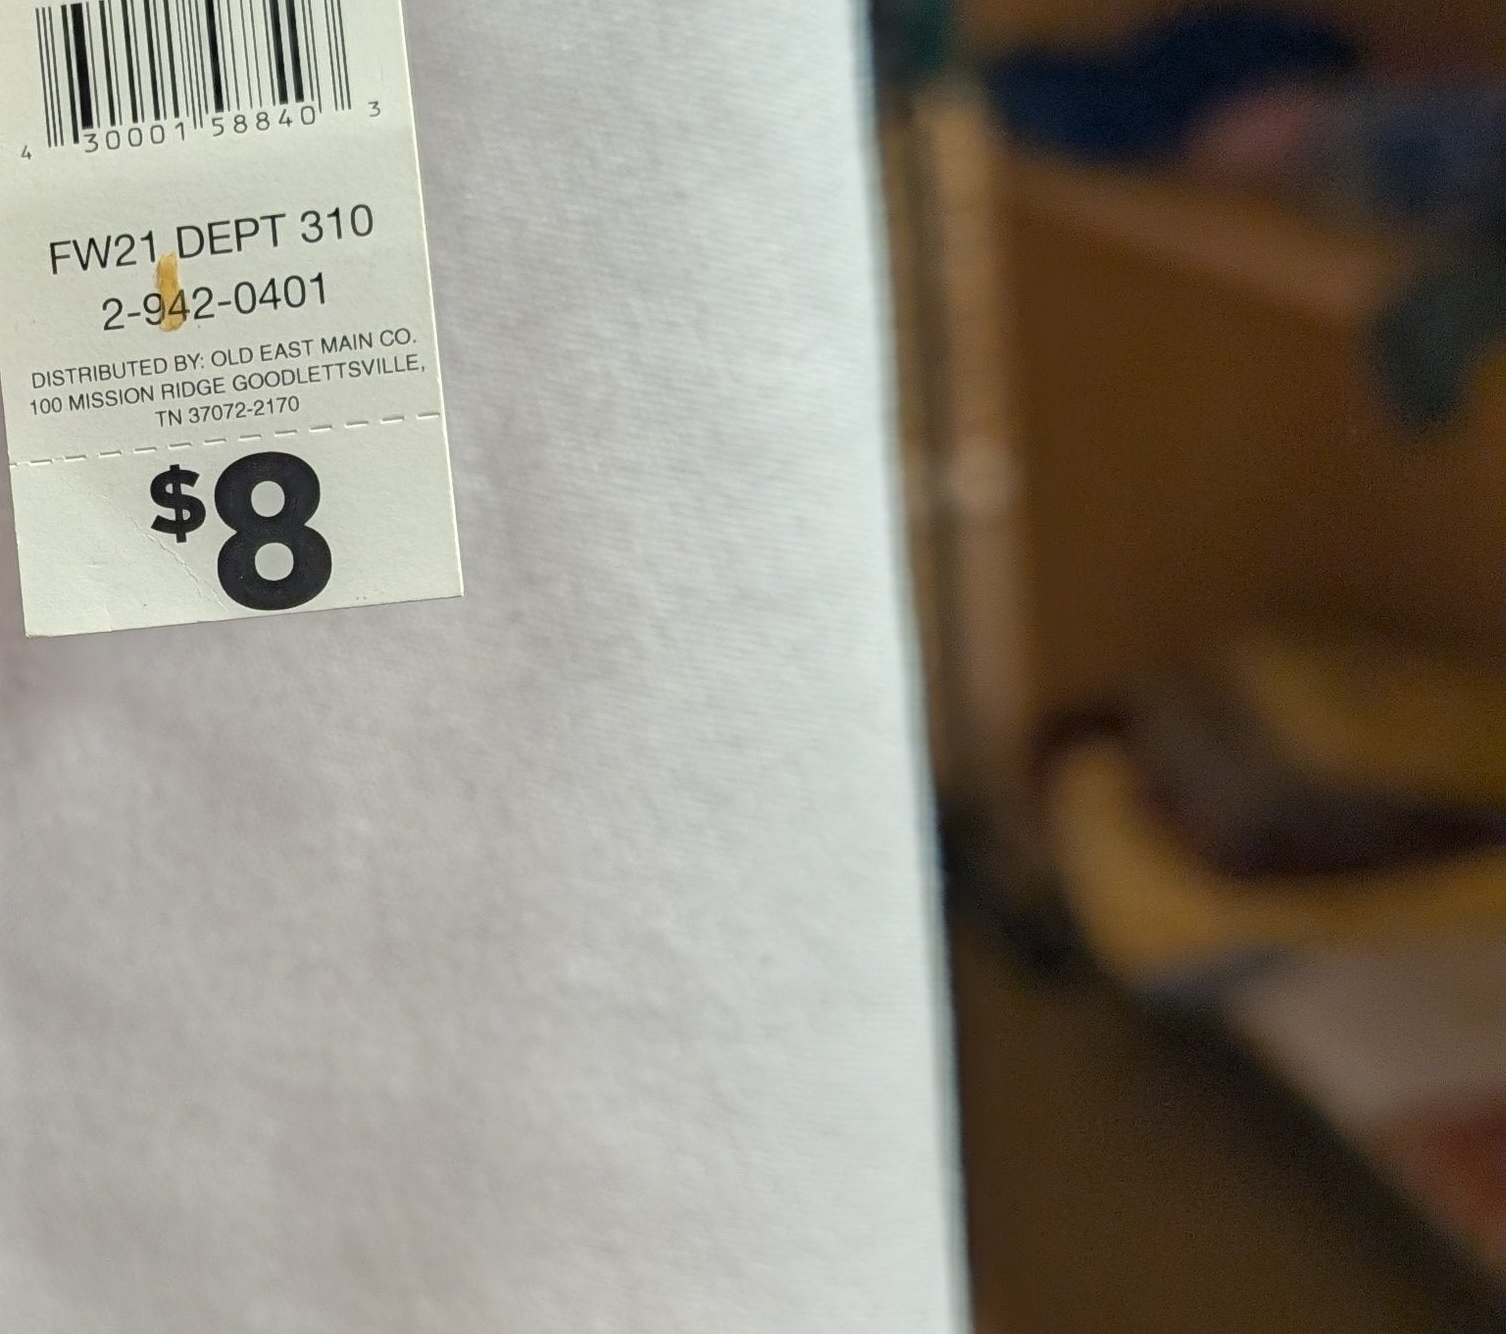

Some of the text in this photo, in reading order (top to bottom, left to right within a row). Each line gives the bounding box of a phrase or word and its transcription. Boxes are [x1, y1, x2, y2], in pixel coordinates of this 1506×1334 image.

[20, 100, 381, 160] 4 30001 58840 3
[49, 204, 374, 275] FW21 DEPT 310
[103, 272, 327, 331] 2-942-0401
[30, 355, 426, 416] 100 MISSION RIDGE GOODLETTSVILLE,
[31, 327, 417, 389] DISTRIBUTED BY: OLD EAST MAIN CO.
[156, 396, 300, 427] TN 37072-2170
[150, 451, 332, 611] $8
